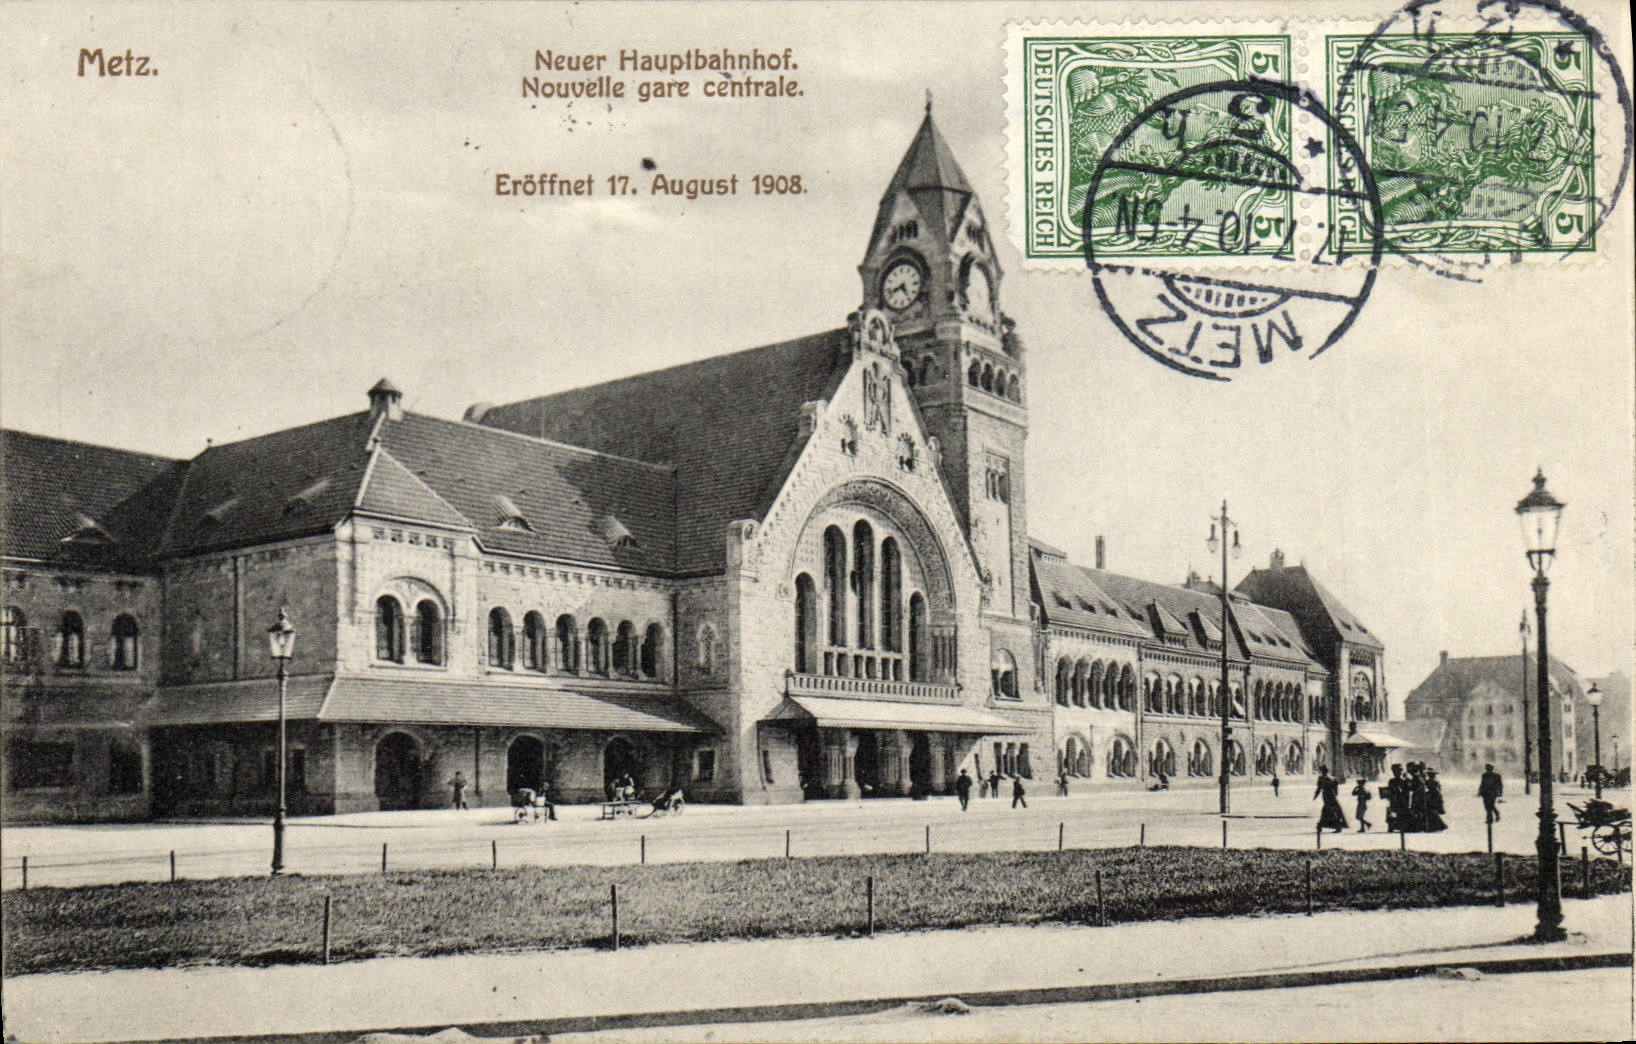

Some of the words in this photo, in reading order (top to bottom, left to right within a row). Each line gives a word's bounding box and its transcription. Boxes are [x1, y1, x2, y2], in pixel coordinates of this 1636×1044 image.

[1252, 51, 1279, 74] 5
[1034, 48, 1053, 172] DEUTSCHES
[1036, 181, 1054, 247] REICH
[1254, 215, 1282, 239] 5
[1338, 177, 1357, 243] REICH
[1556, 212, 1584, 235] 5
[1136, 294, 1304, 369] METZ
